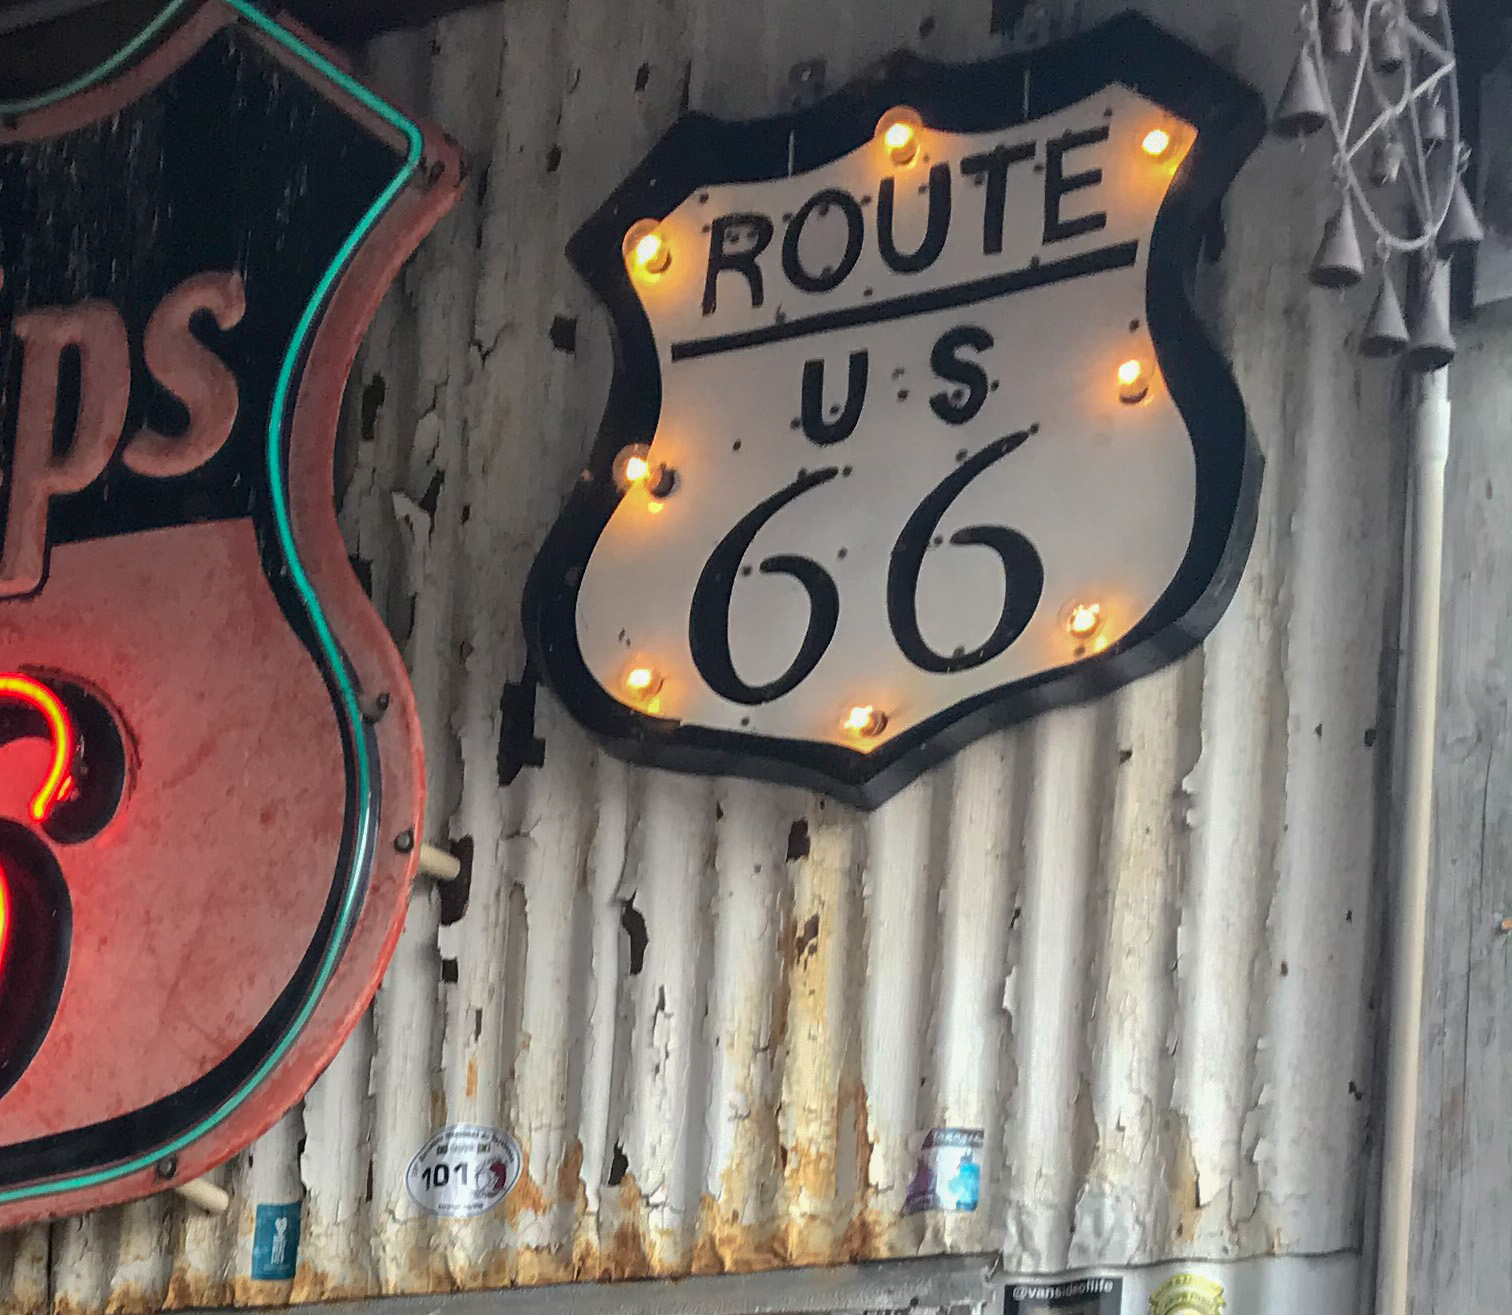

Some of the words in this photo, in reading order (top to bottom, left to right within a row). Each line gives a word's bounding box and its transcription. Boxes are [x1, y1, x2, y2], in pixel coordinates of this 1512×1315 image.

[702, 125, 1111, 316] ROUTE
[688, 428, 1045, 705] 66
[421, 1162, 469, 1192] 101
